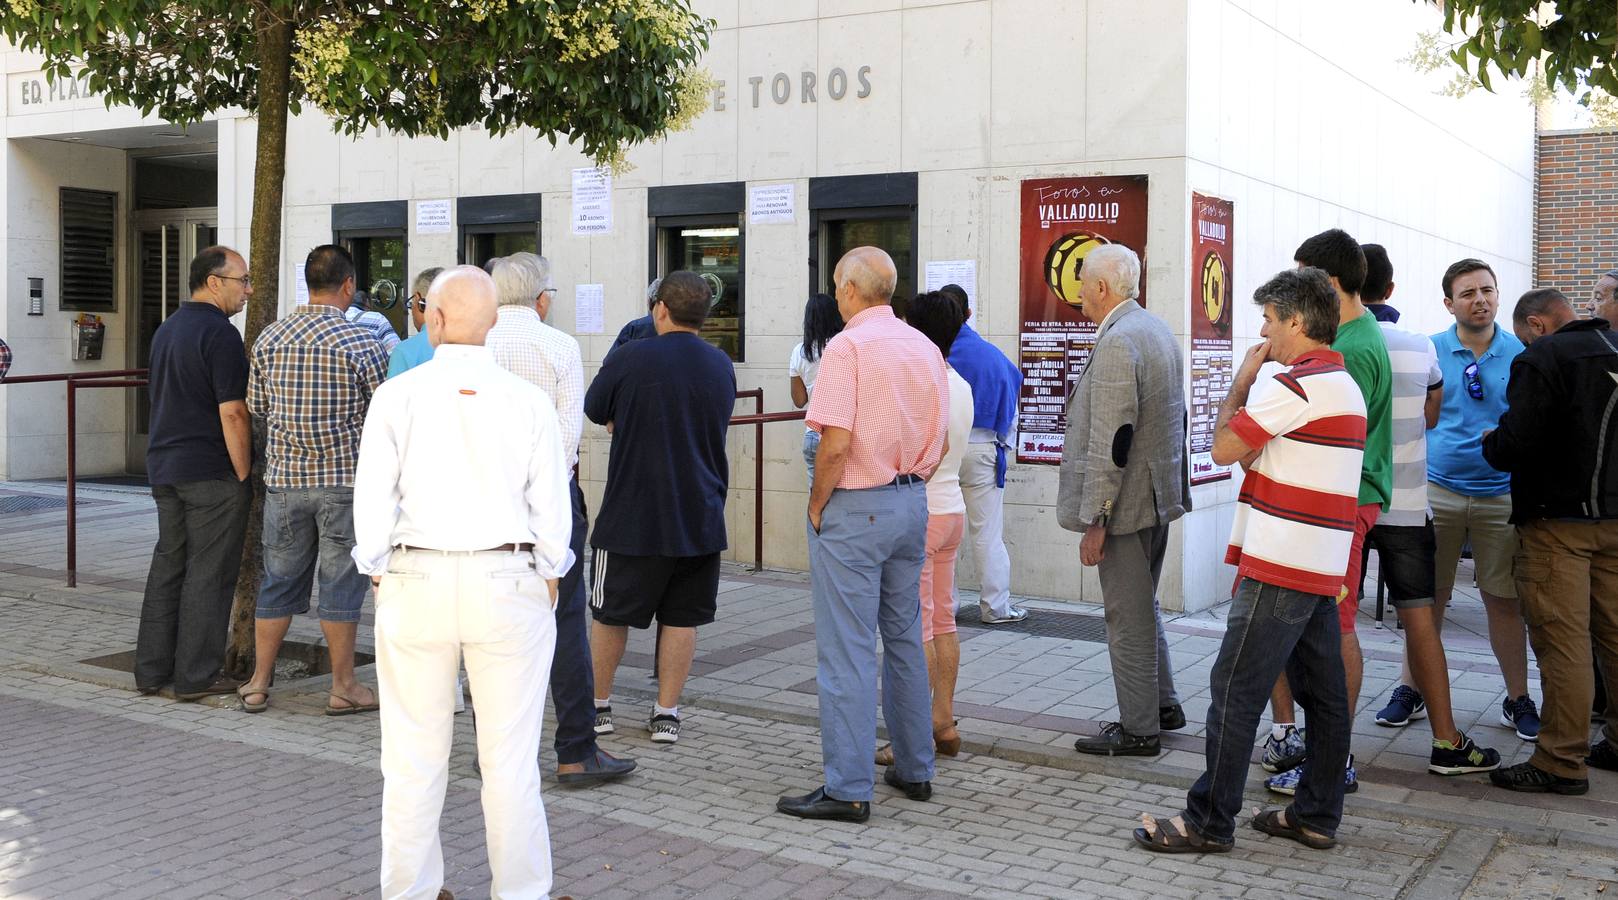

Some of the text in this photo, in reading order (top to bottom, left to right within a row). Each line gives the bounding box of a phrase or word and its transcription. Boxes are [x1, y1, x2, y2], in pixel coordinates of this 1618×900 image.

[21, 75, 95, 105] ED. PLAZ
[748, 65, 872, 109] TOROS
[1039, 203, 1119, 221] VALLADOLID
[1027, 369, 1039, 377] JOSÉ
[1040, 369, 1058, 378] TOMÁS
